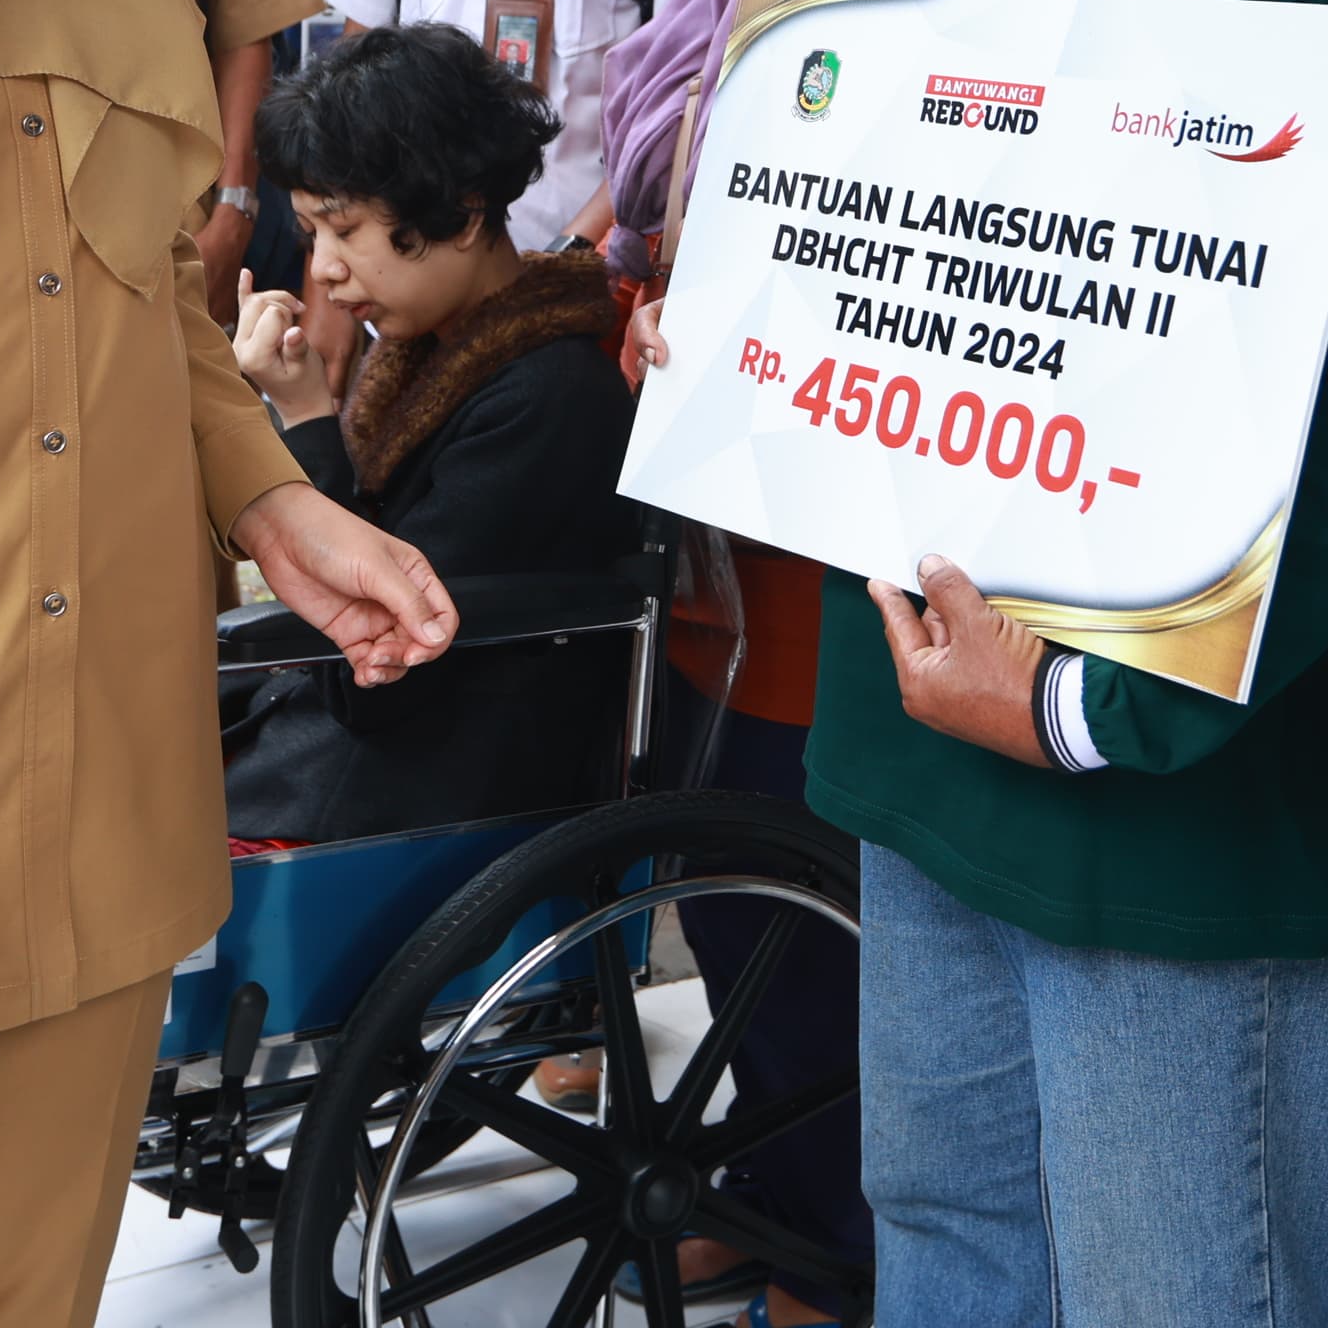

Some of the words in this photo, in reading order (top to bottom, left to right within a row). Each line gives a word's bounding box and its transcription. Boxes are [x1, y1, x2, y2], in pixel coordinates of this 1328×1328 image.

[919, 97, 1039, 135] REBOUND
[933, 78, 1037, 103] BANYUWANGI
[727, 162, 893, 224] BANTUAN
[899, 189, 1116, 263] LANGSUNG
[1130, 224, 1269, 289] TUNAI
[771, 223, 914, 285] DBHCHT
[924, 250, 1136, 331] TRIWULAN
[1145, 291, 1176, 338] II
[833, 292, 957, 356] TAHUN
[963, 322, 1066, 380] 2024
[738, 337, 786, 384] Rp.
[791, 357, 1141, 515] 450.000,-
